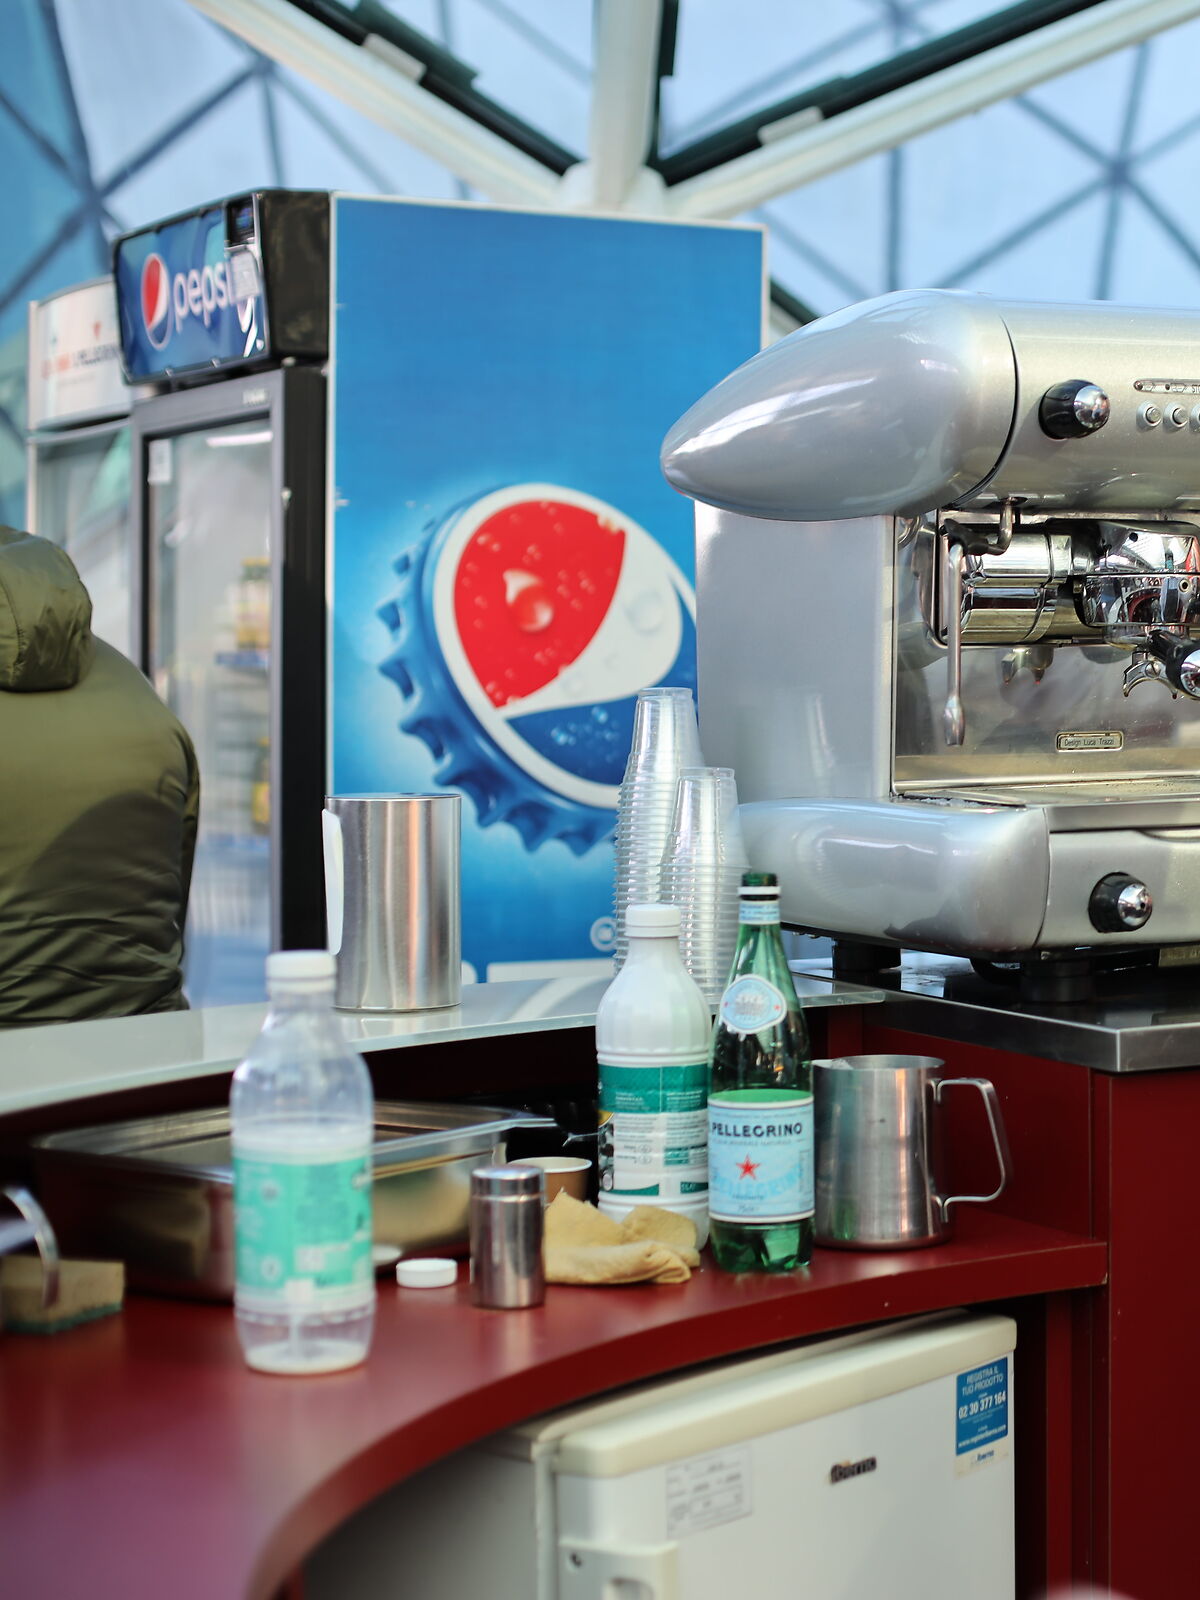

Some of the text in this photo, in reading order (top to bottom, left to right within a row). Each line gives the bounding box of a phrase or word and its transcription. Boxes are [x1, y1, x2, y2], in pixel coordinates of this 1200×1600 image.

[1064, 738, 1081, 747] Design
[1083, 738, 1096, 746] Luca
[711, 1122, 803, 1138] PELLEGRINO
[966, 1367, 993, 1384] REGISTRA
[962, 1384, 974, 1396] TUO
[974, 1373, 1004, 1391] PRODOTTO
[958, 1405, 968, 1419] 02
[969, 1400, 979, 1415] 30
[980, 1395, 993, 1412] 377
